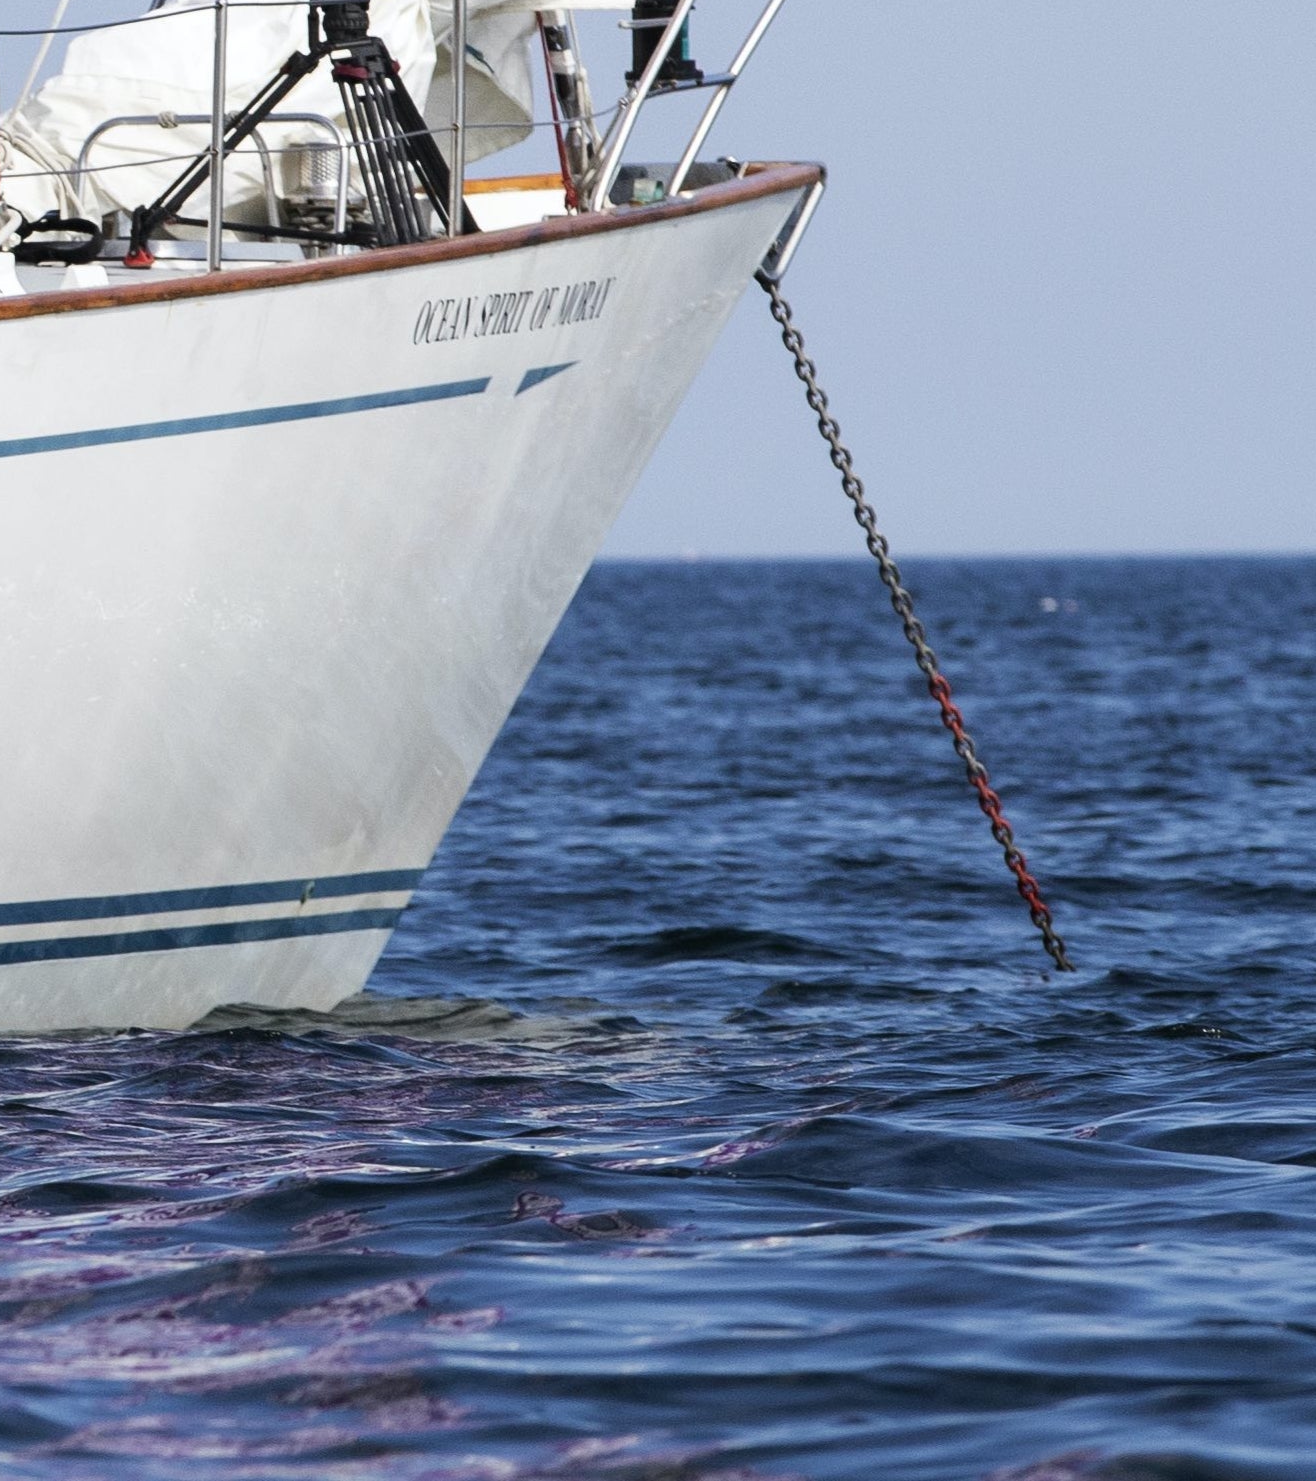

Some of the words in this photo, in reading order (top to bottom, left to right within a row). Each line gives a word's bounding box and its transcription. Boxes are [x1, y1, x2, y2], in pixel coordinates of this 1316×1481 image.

[413, 297, 477, 344] OCEAN
[474, 290, 534, 338] SPIRIT
[529, 286, 561, 331] OF
[552, 276, 618, 327] MORAY
